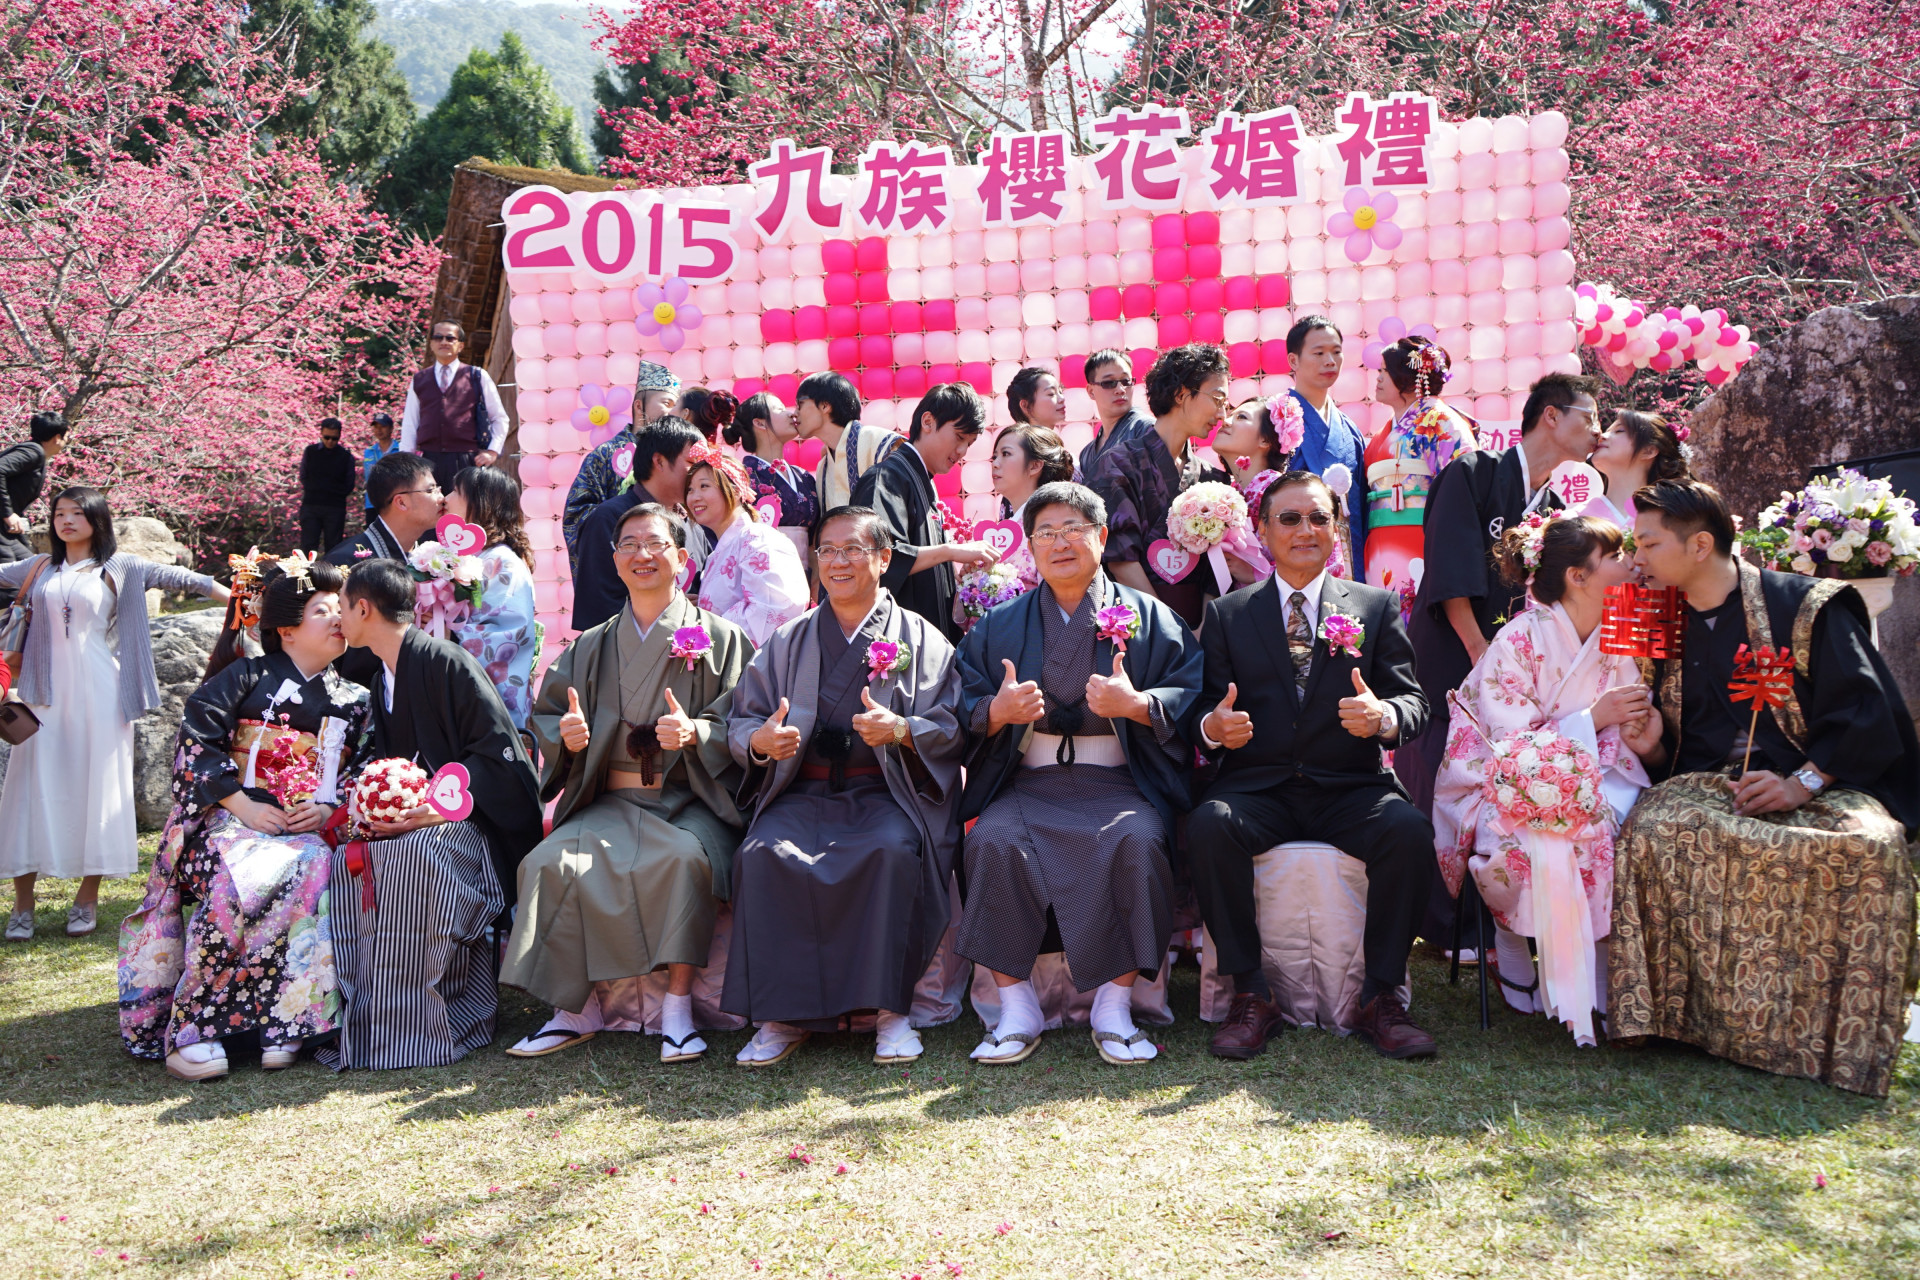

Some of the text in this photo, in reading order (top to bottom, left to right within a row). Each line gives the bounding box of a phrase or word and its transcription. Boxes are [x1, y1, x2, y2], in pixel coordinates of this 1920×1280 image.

[507, 97, 1431, 279] 2015 九族櫻花婚禮
[1549, 473, 1590, 504] 禮
[451, 532, 465, 547] 2
[990, 534, 1007, 548] 12
[1164, 555, 1184, 570] 15
[440, 788, 455, 799] 7
